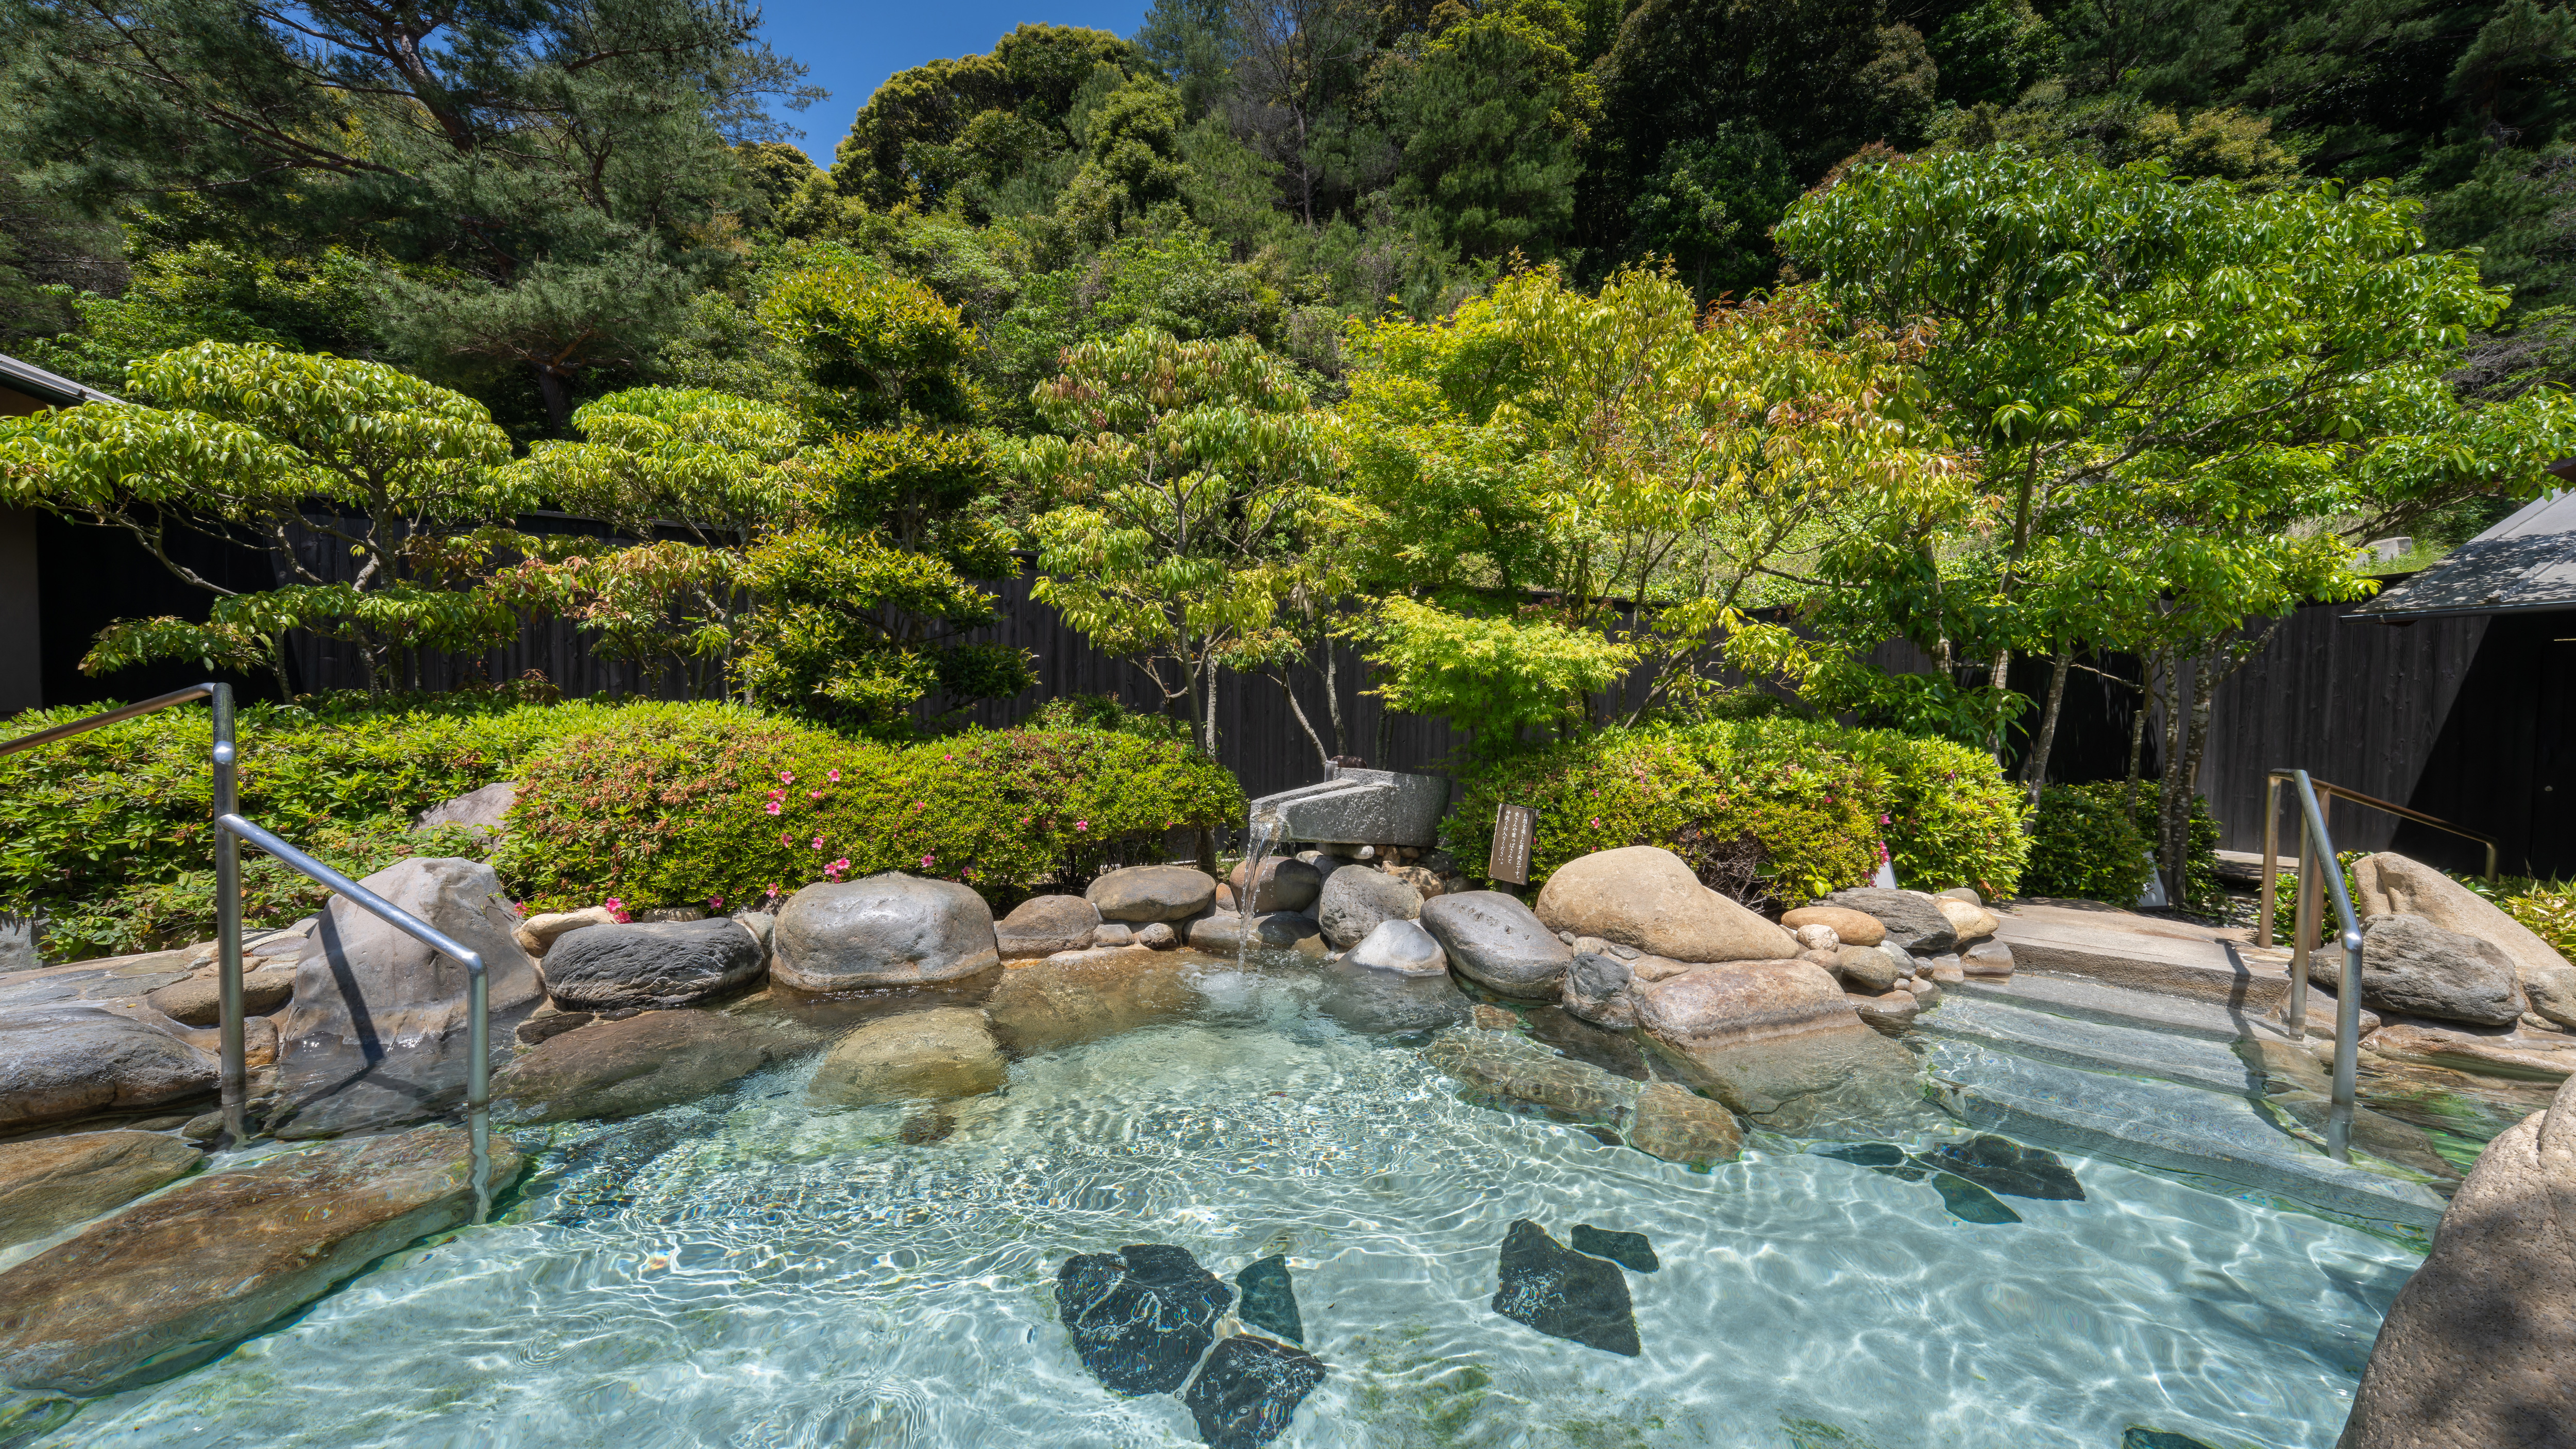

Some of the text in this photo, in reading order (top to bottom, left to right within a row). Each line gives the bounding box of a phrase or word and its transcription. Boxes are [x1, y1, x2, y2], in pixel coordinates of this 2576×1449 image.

[1498, 810, 1511, 865] 仲良くお入りください。
